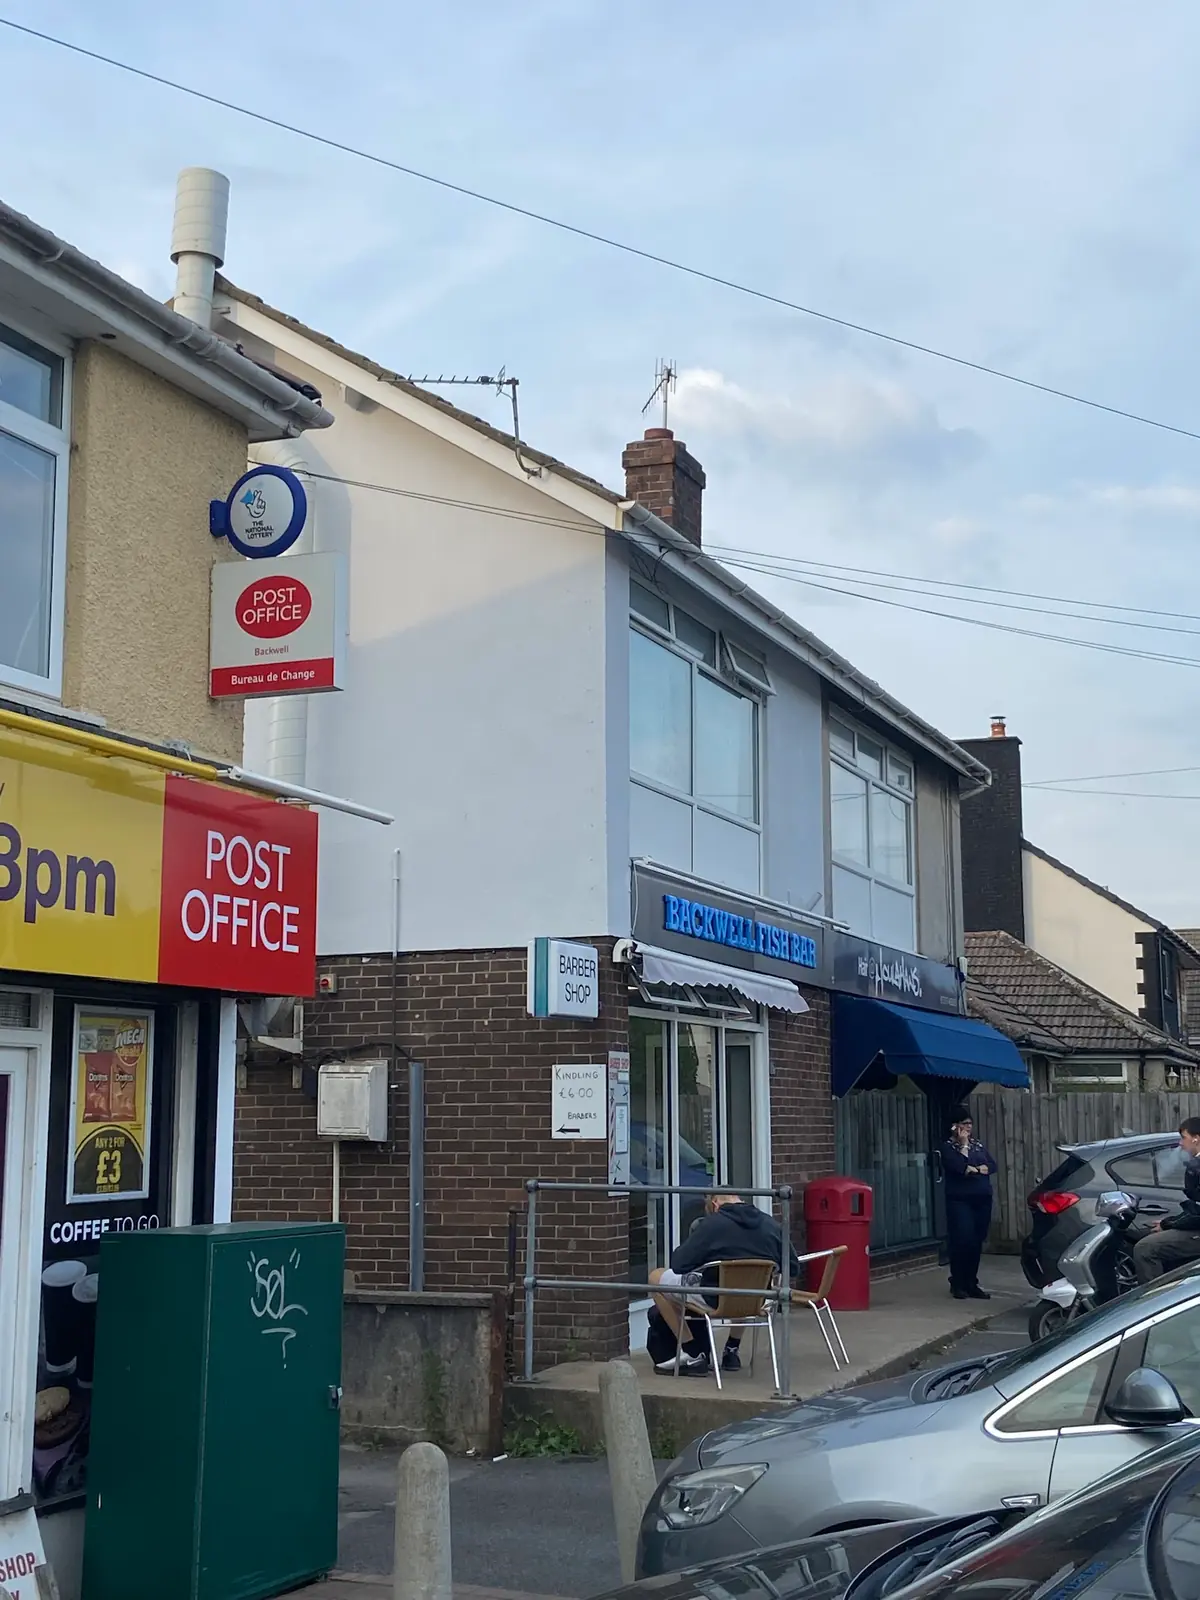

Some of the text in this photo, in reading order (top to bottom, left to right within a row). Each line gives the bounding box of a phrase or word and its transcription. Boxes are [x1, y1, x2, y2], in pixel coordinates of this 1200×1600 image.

[245, 525, 274, 534] NATIONAL
[247, 531, 273, 540] LOTTERY
[253, 587, 297, 606] POST
[242, 604, 302, 625] OFFICE
[254, 645, 289, 656] Backwell
[231, 668, 315, 686] Bureau de Change
[206, 830, 291, 892] POST
[181, 889, 300, 953] OFFICE
[663, 894, 817, 969] BACKWELL FISH BAR
[559, 955, 597, 979] BARBER
[564, 982, 592, 1004] SHOP
[115, 1028, 145, 1049] MEGA
[555, 1067, 599, 1081] KINDLING
[567, 1111, 597, 1120] BARBERS
[95, 1136, 126, 1149] ANY 2 FOR
[96, 1149, 122, 1185] £3
[50, 1214, 160, 1244] COFFEE TO GO
